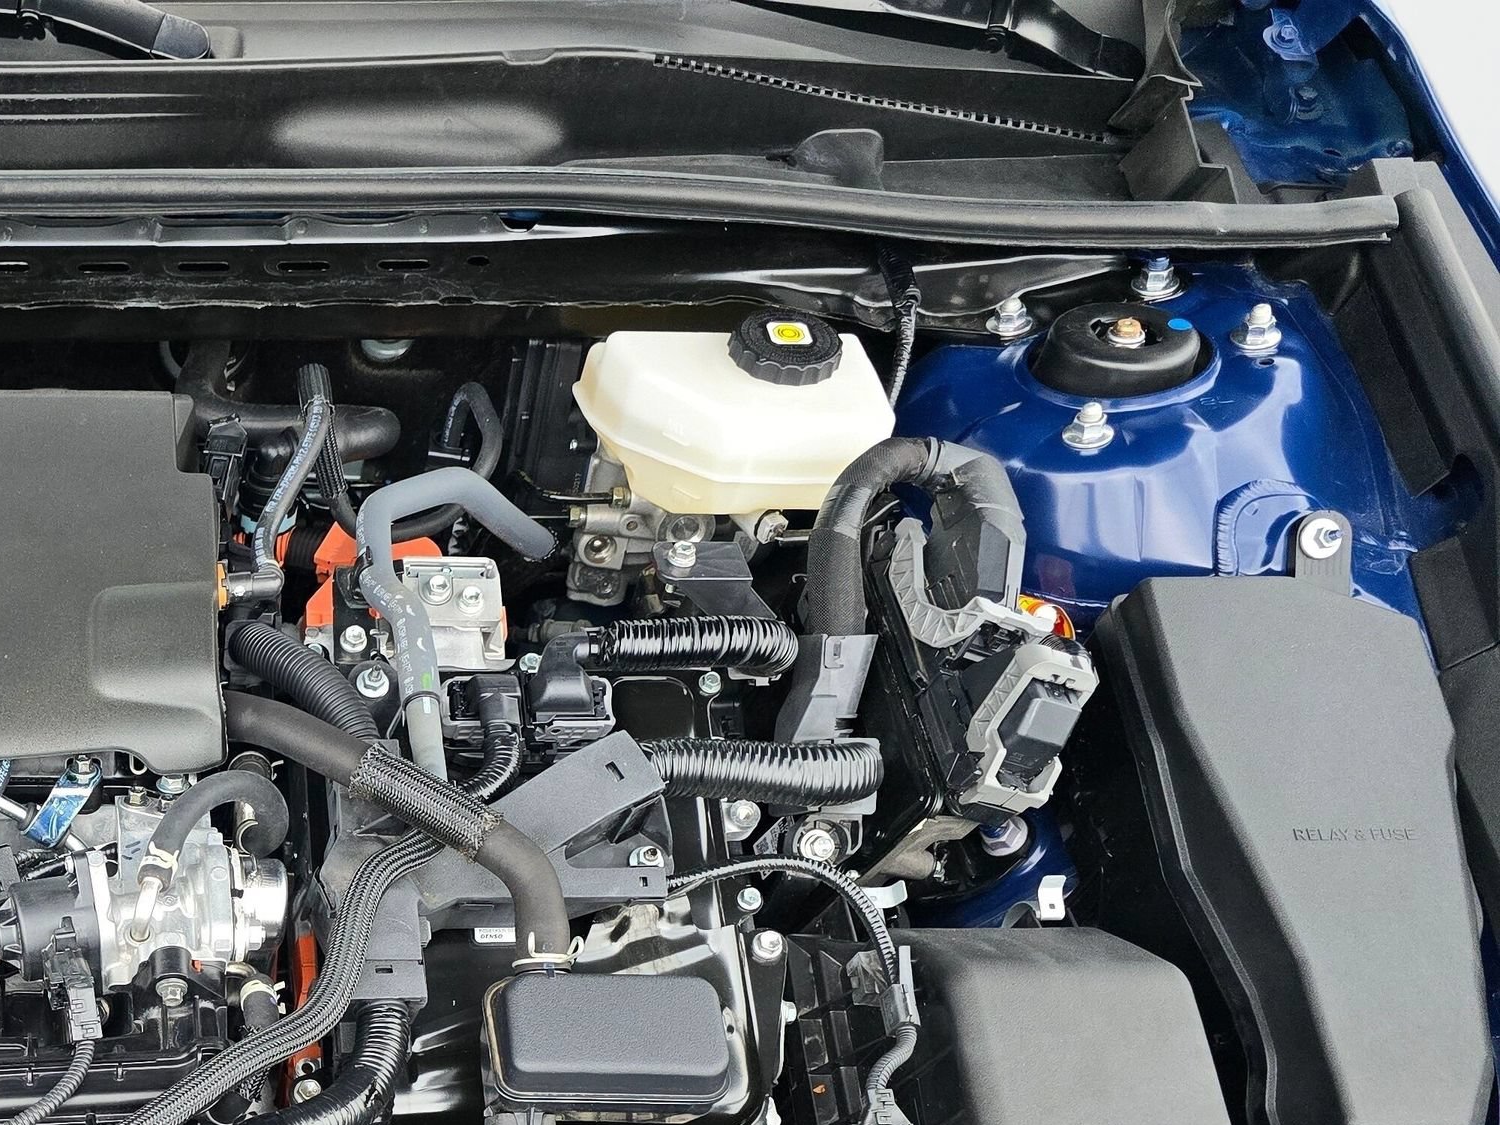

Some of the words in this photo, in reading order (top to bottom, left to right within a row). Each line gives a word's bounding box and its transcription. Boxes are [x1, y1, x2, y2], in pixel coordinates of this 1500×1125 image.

[1293, 827, 1349, 841] RELAY
[1354, 829, 1367, 841] &
[1370, 827, 1418, 841] FUSE
